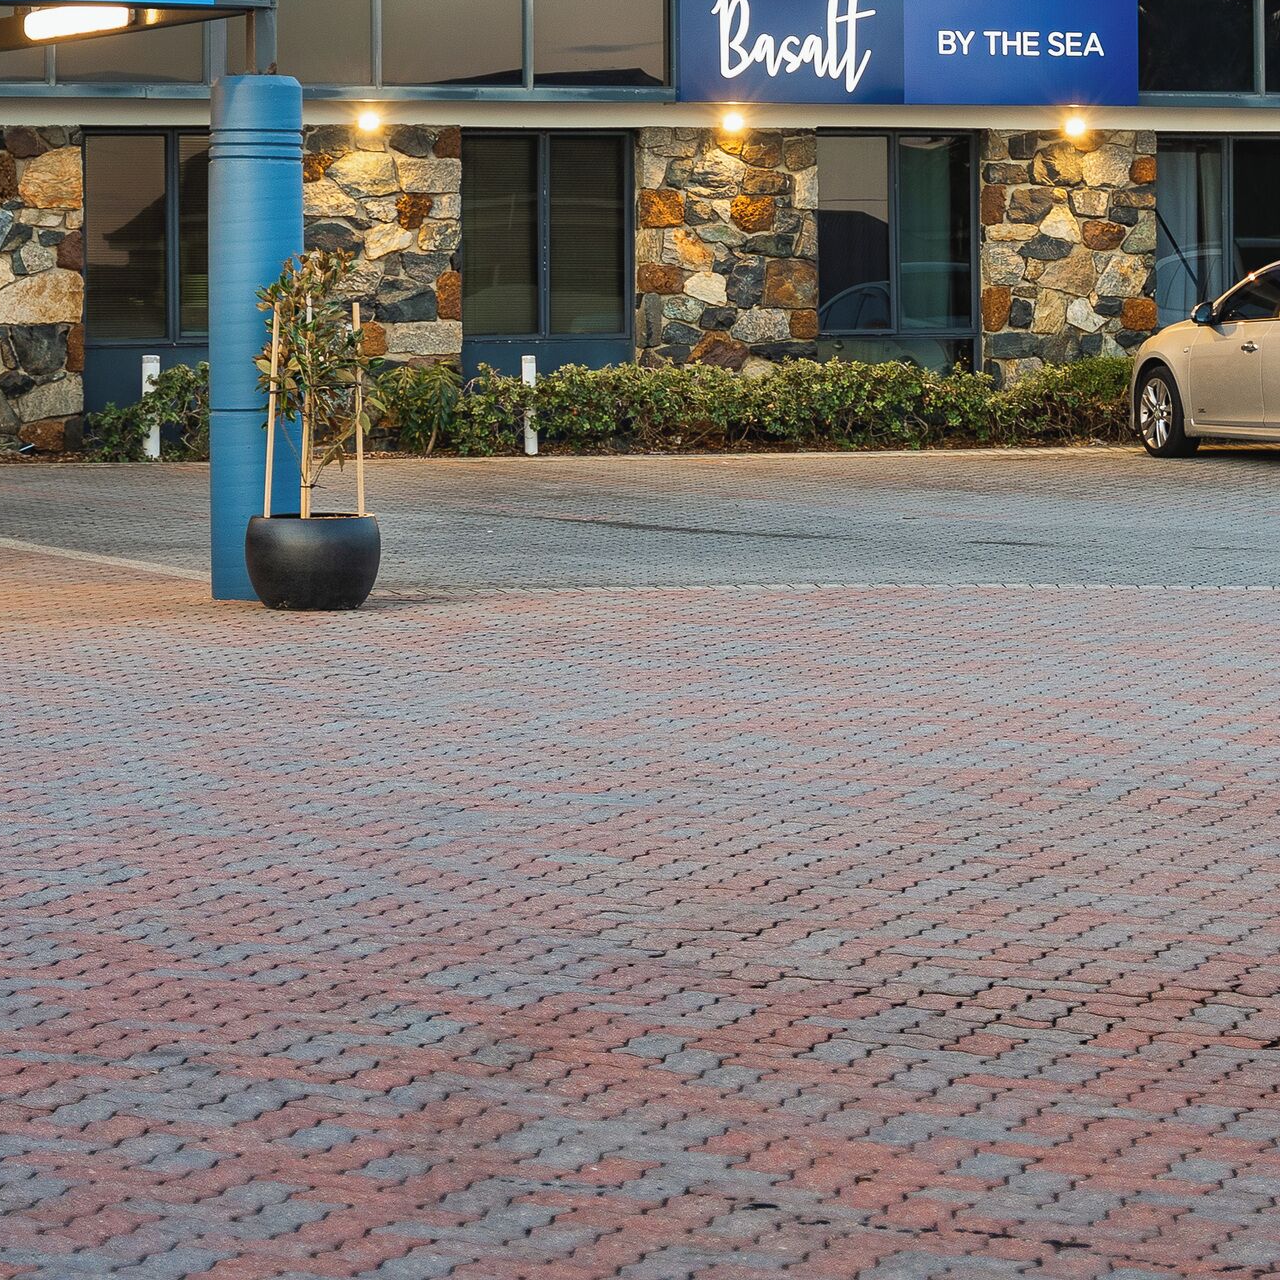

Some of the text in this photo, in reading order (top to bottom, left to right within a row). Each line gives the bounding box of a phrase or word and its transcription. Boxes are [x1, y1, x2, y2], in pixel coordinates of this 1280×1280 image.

[938, 30, 1106, 57] BY THE SEA
